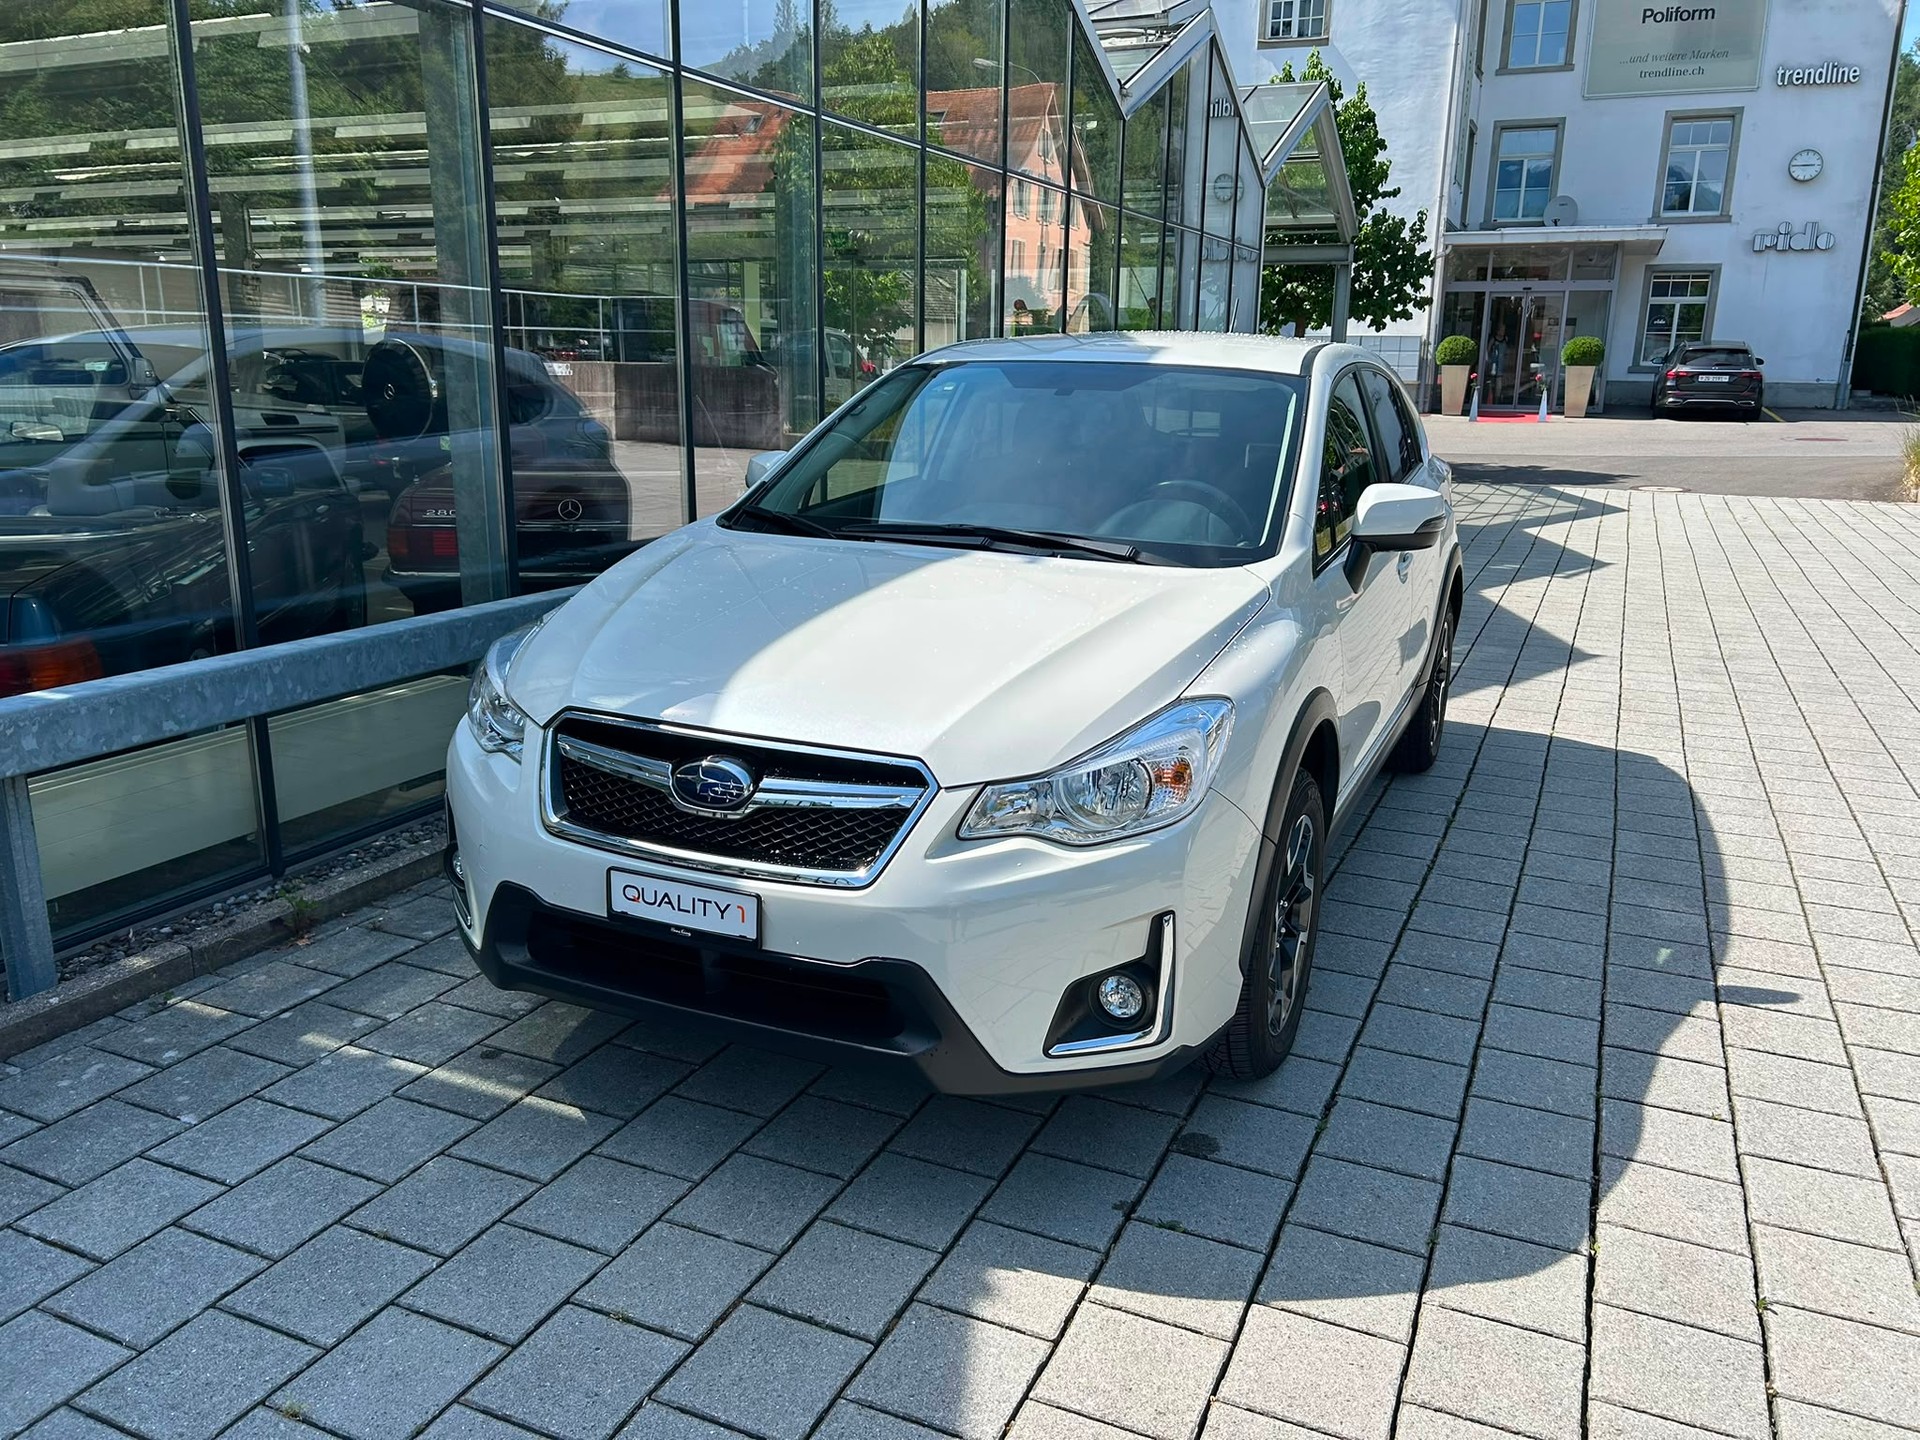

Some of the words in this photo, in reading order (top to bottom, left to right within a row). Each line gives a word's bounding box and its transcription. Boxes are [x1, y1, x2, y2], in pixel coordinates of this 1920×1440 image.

[1642, 6, 1715, 24] Poliform
[1651, 52, 1688, 62] weitere
[1689, 49, 1730, 60] Marken
[1639, 66, 1705, 79] trendline.ch
[1776, 61, 1861, 87] trendline
[1752, 221, 1836, 253] rido
[622, 884, 732, 920] QUALITY
